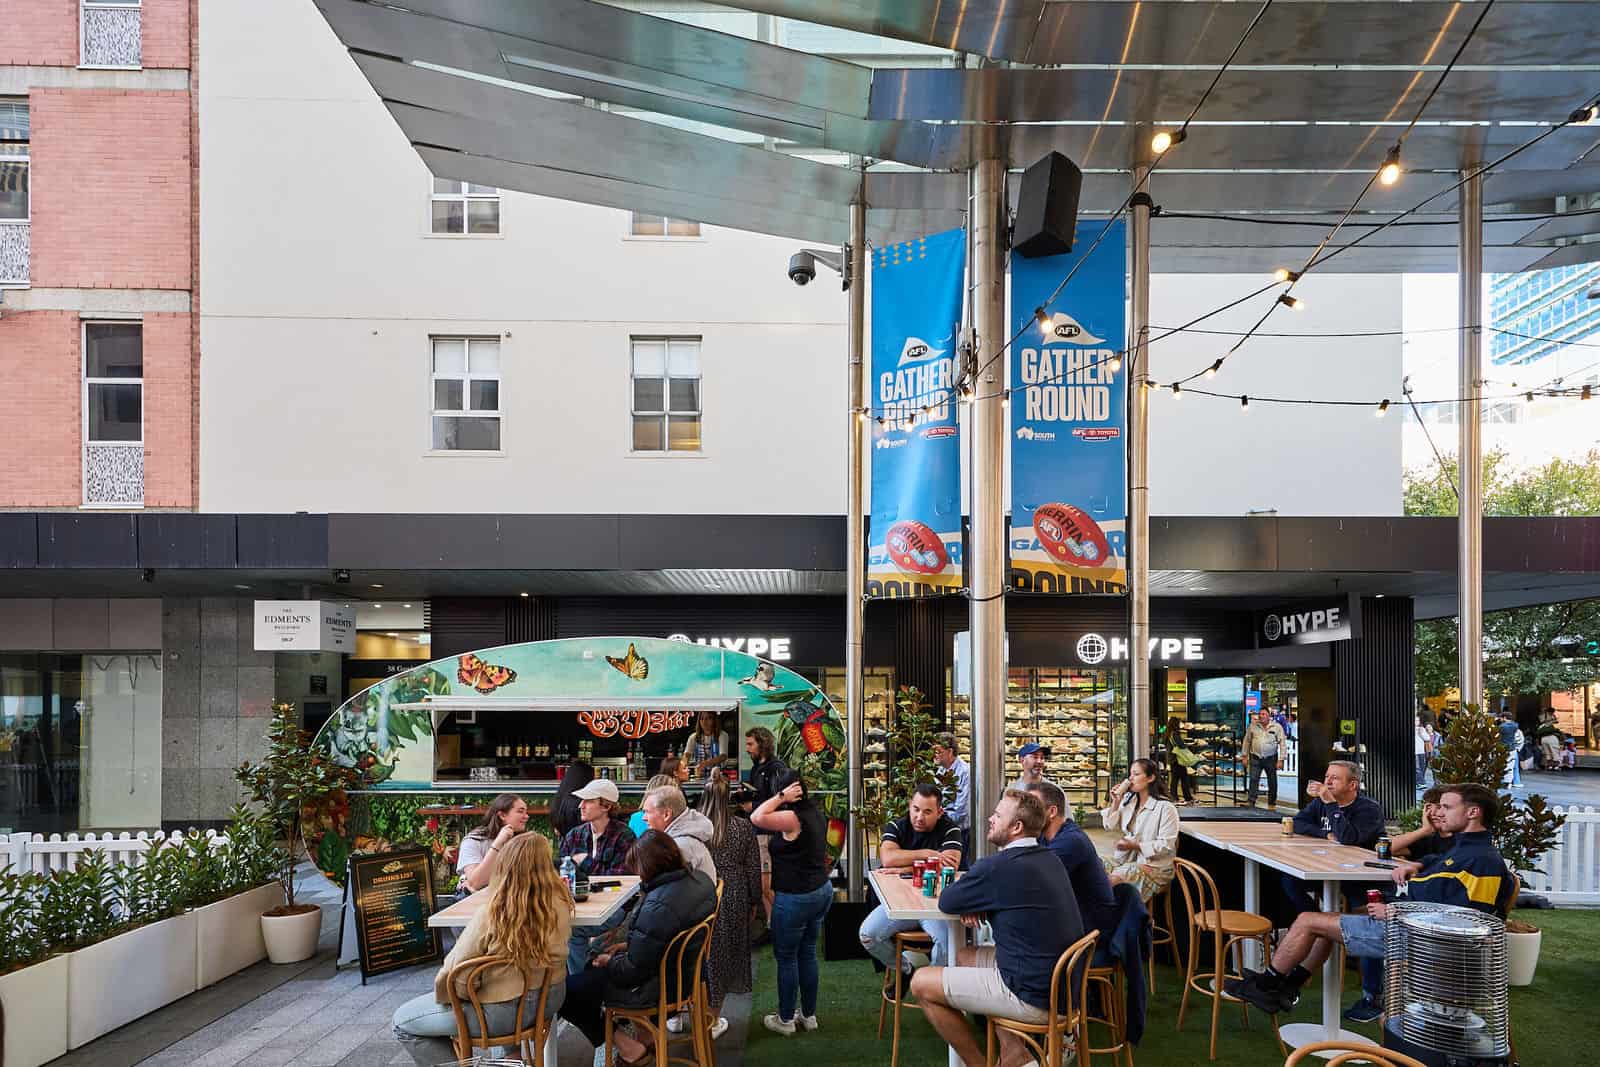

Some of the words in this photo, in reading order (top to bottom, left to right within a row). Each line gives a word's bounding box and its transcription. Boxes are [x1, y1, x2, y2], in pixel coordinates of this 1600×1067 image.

[1056, 326, 1079, 335] AFL
[908, 347, 927, 357] AFL
[880, 358, 953, 402] GATHER
[1021, 348, 1114, 385] GATHER
[883, 389, 950, 433] ROUND
[1025, 386, 1110, 421] ROUND
[264, 615, 312, 624] EDMENTS
[325, 616, 352, 629] EDMENTS
[1282, 608, 1340, 635] HYPE
